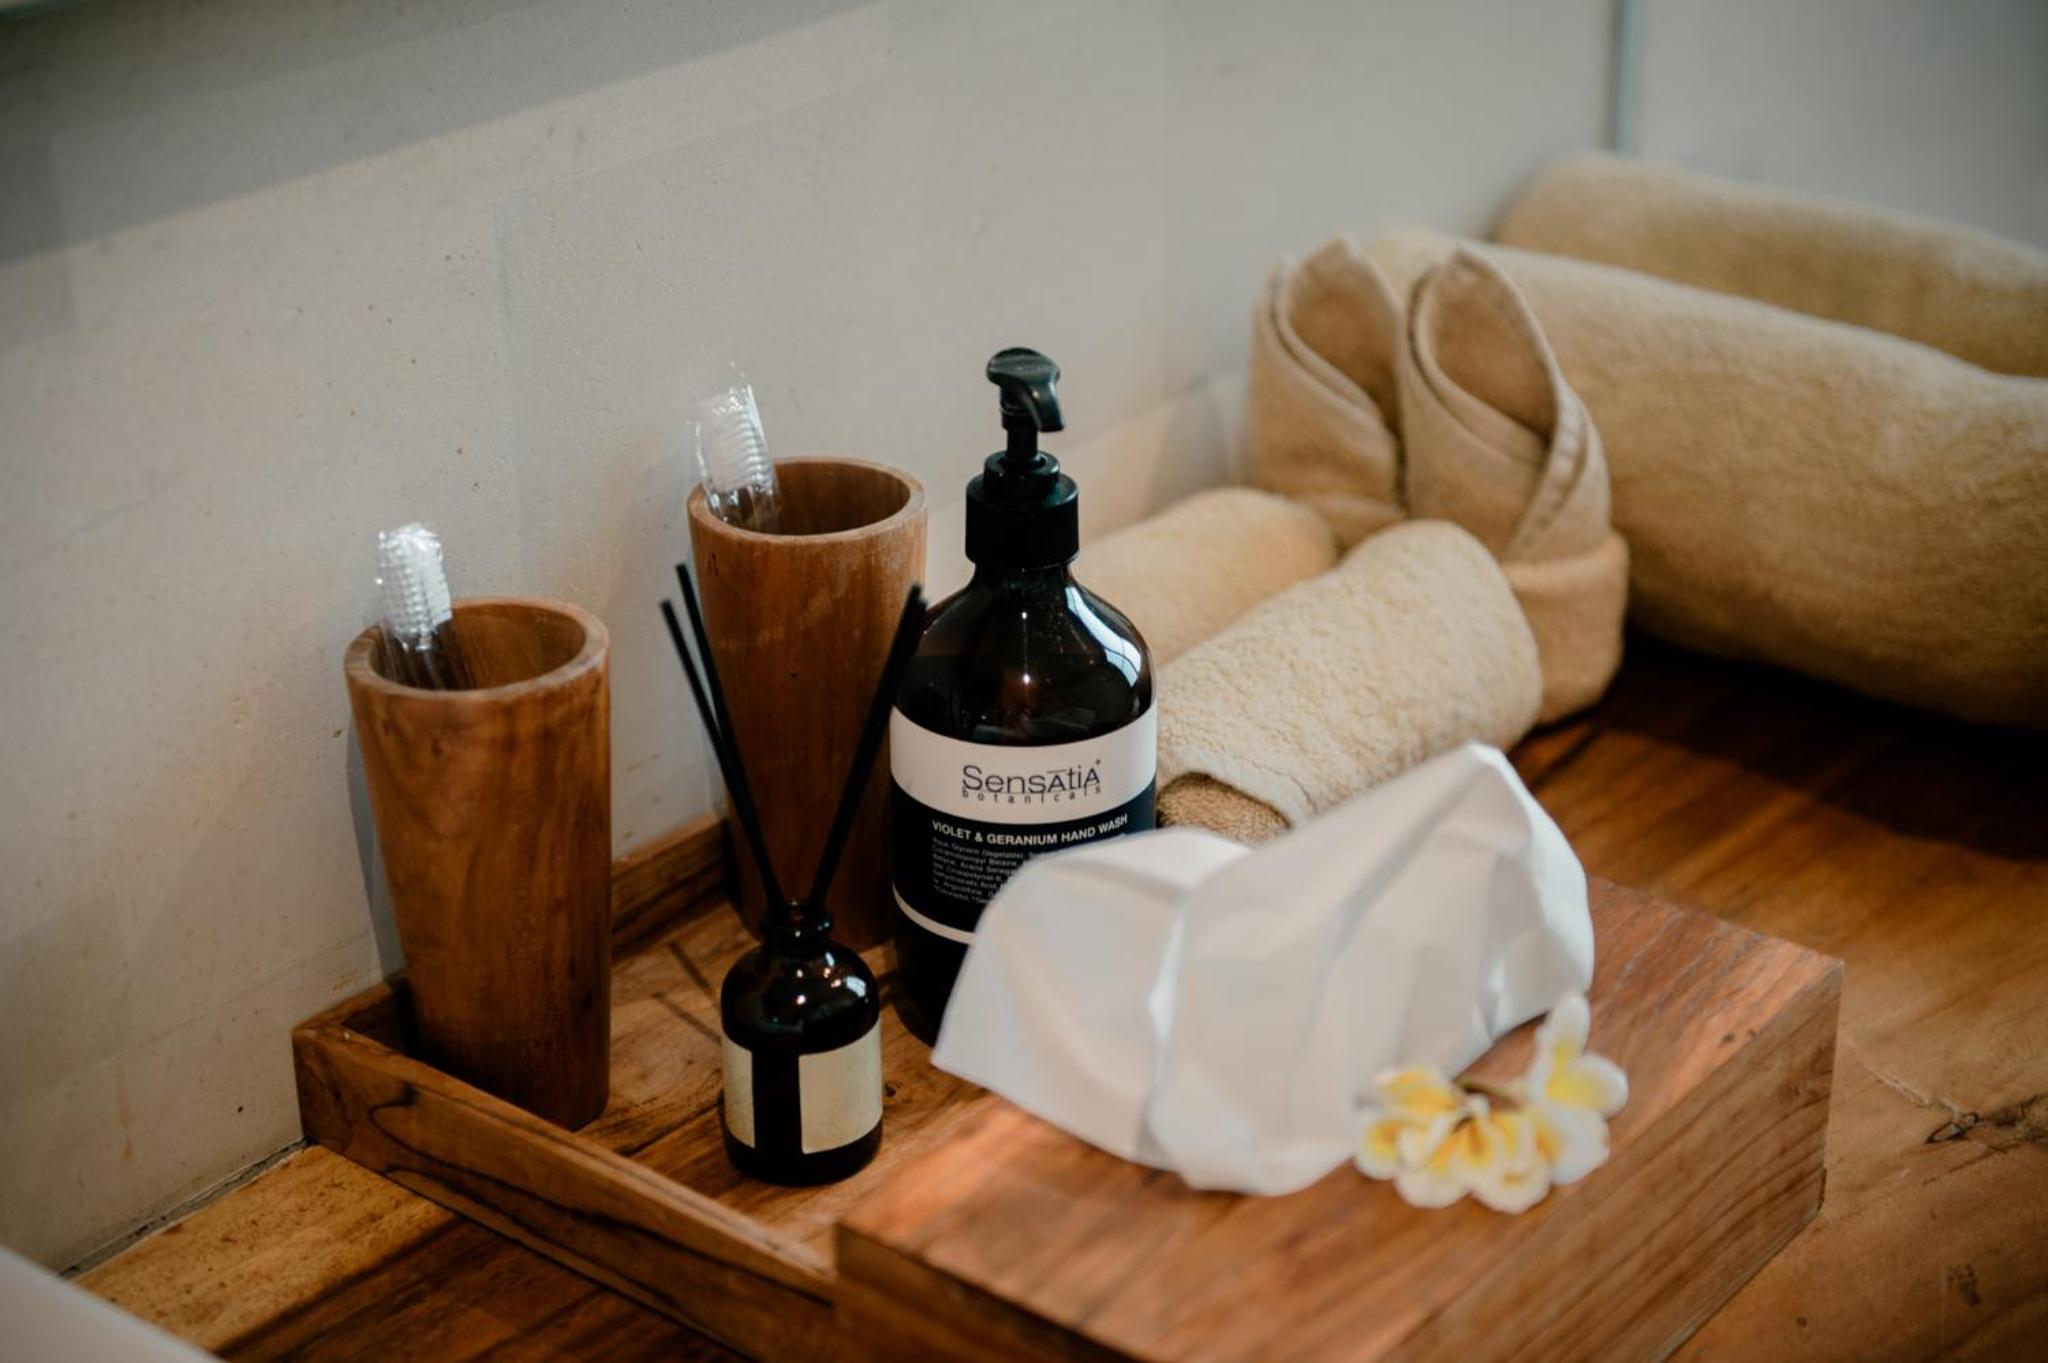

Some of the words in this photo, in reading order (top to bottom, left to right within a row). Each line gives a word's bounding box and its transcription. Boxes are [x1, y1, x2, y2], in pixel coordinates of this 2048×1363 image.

[962, 785, 1101, 804] botanicals
[932, 820, 971, 840] VIOLET
[974, 832, 983, 842] &
[986, 833, 1058, 846] GERANIUM
[1061, 826, 1096, 842] HAND
[1098, 813, 1128, 834] WASH
